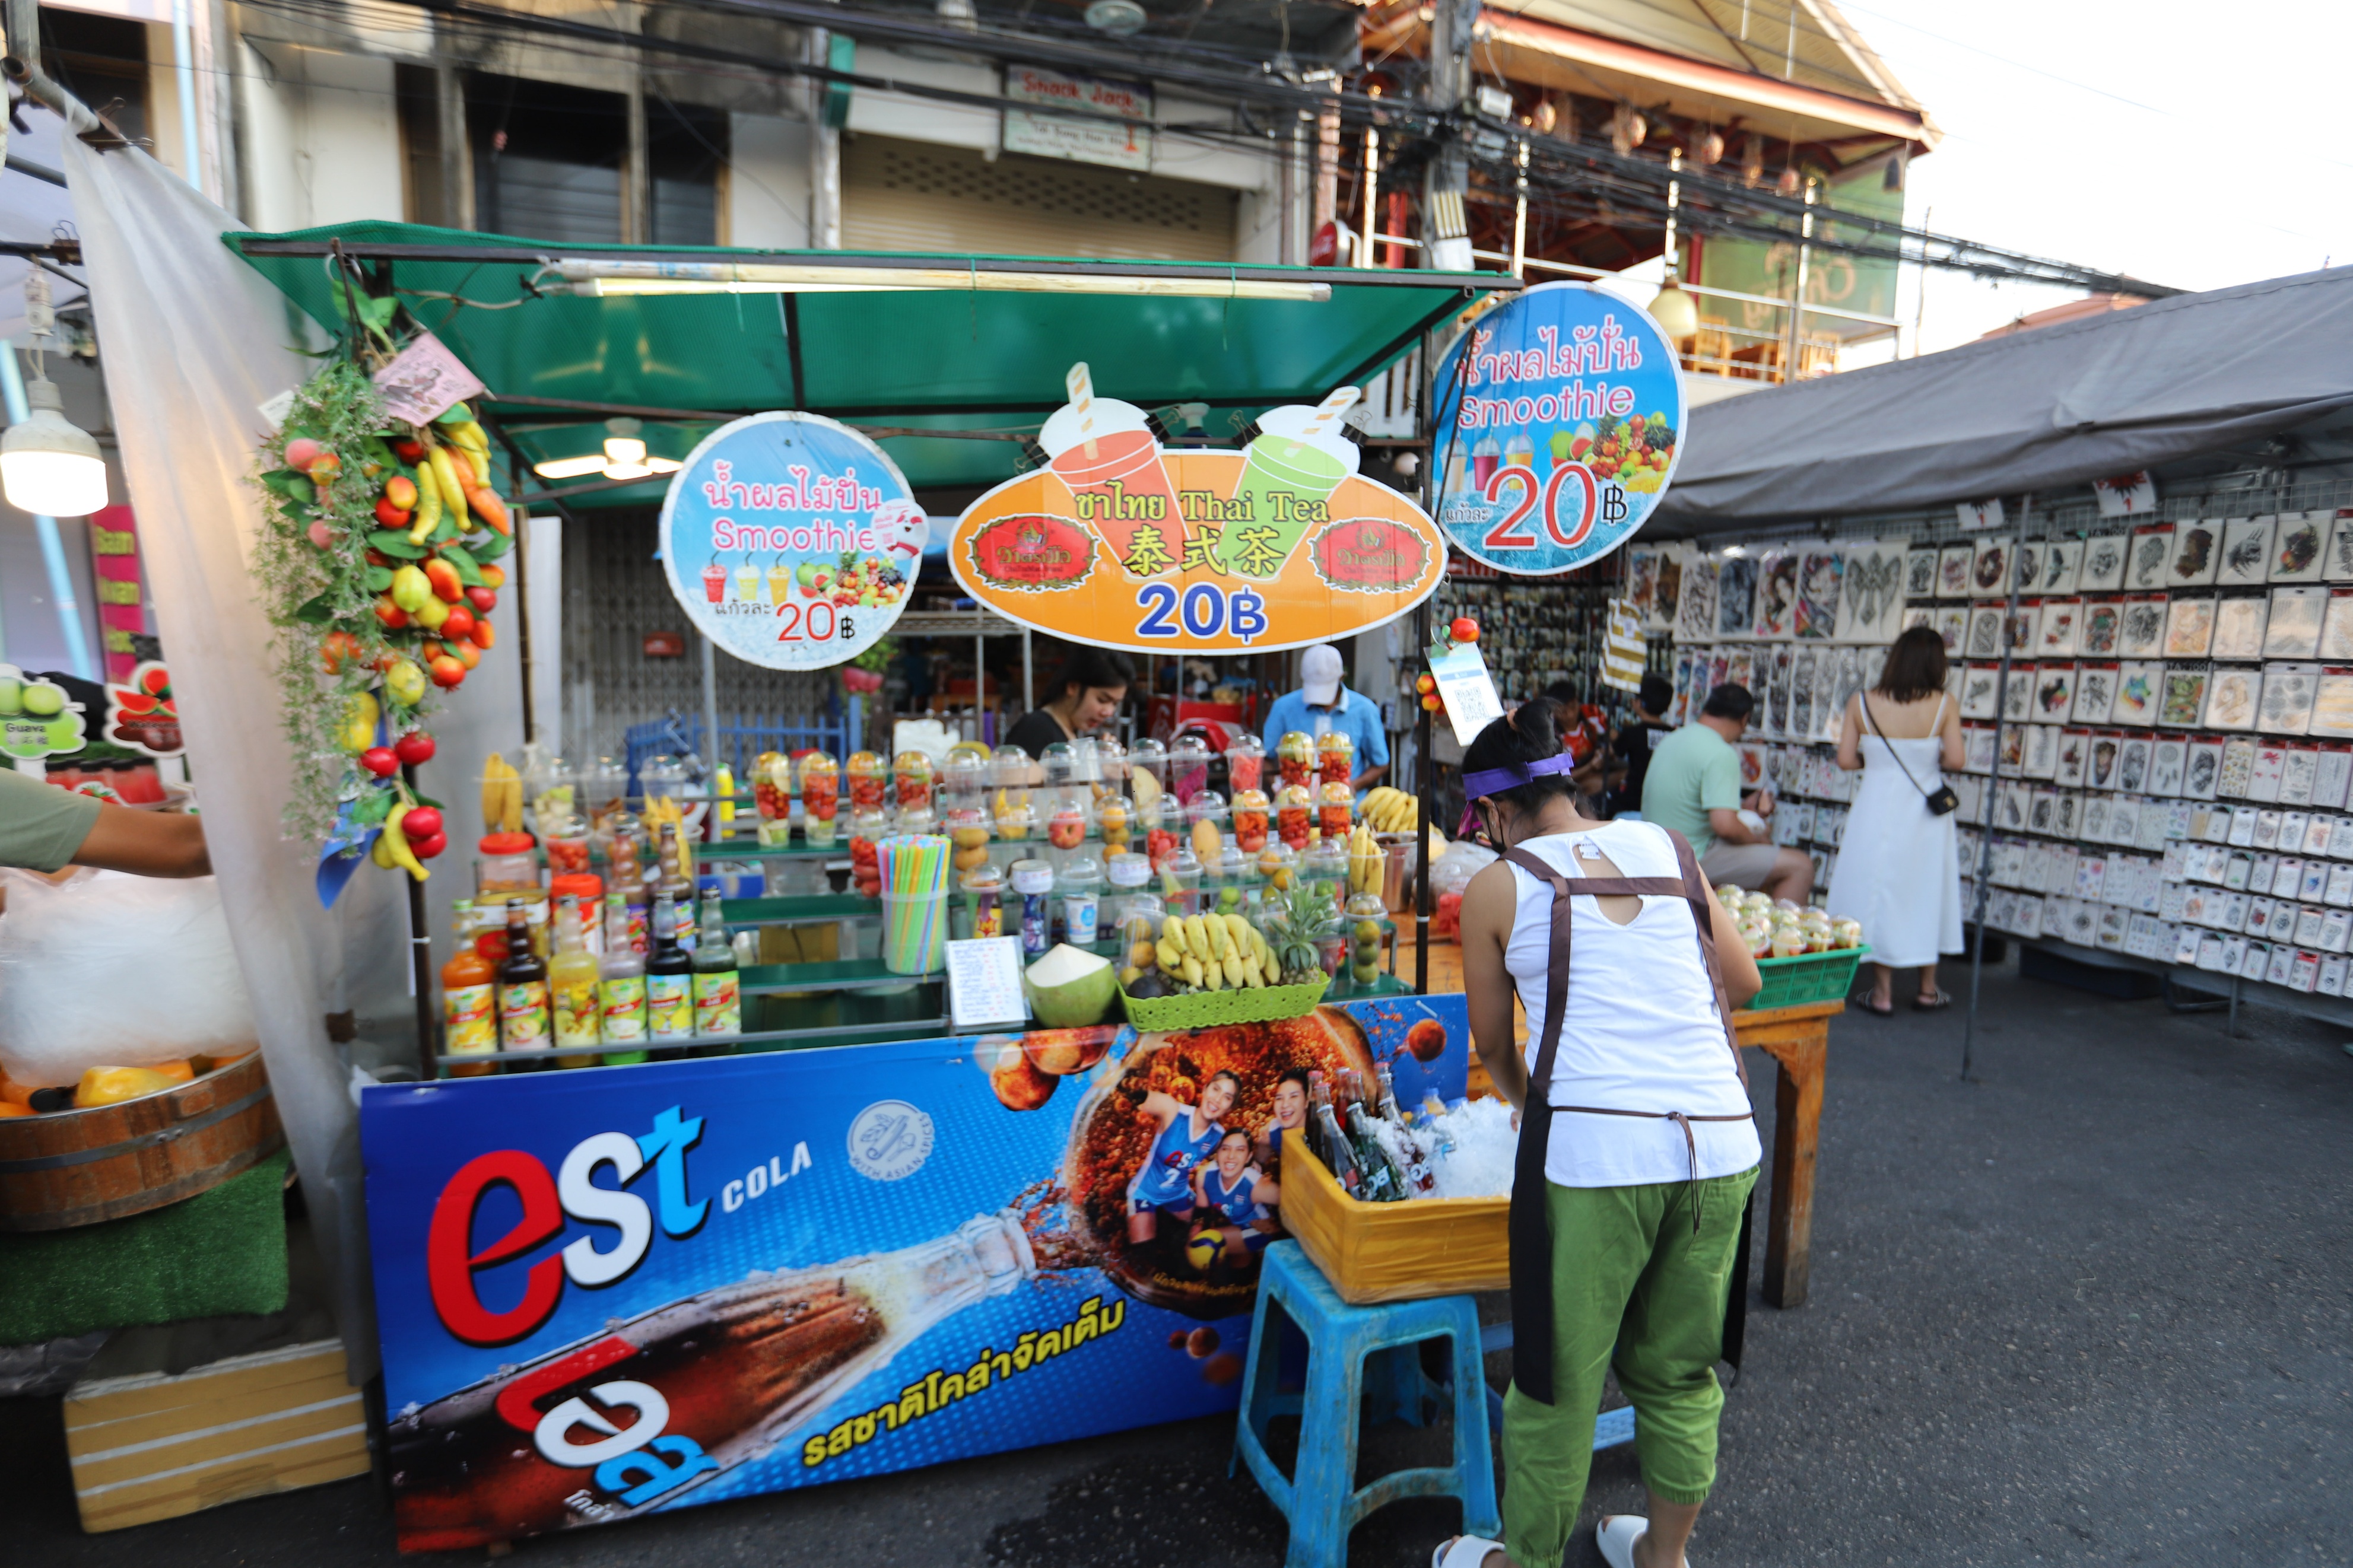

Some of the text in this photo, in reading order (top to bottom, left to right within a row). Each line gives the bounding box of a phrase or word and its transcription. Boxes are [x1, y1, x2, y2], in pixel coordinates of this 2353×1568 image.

[1458, 314, 1641, 386] น้ำผลไม้ปั่น
[706, 462, 882, 510] น้ำผลไม้ปั่น
[1075, 481, 1329, 522] ชาไทย Thai Tea
[714, 519, 875, 551] Smoothie
[1123, 525, 1285, 576] 泰式茶
[715, 599, 772, 615] แก้วละ
[5, 723, 46, 733] Guava
[852, 1114, 933, 1179] WITH ASIAN SPICES
[1159, 1168, 1180, 1188] 2
[428, 1104, 812, 1346] est COLA
[801, 1295, 1126, 1468] รสชาติโคล่าจัดเต็ม
